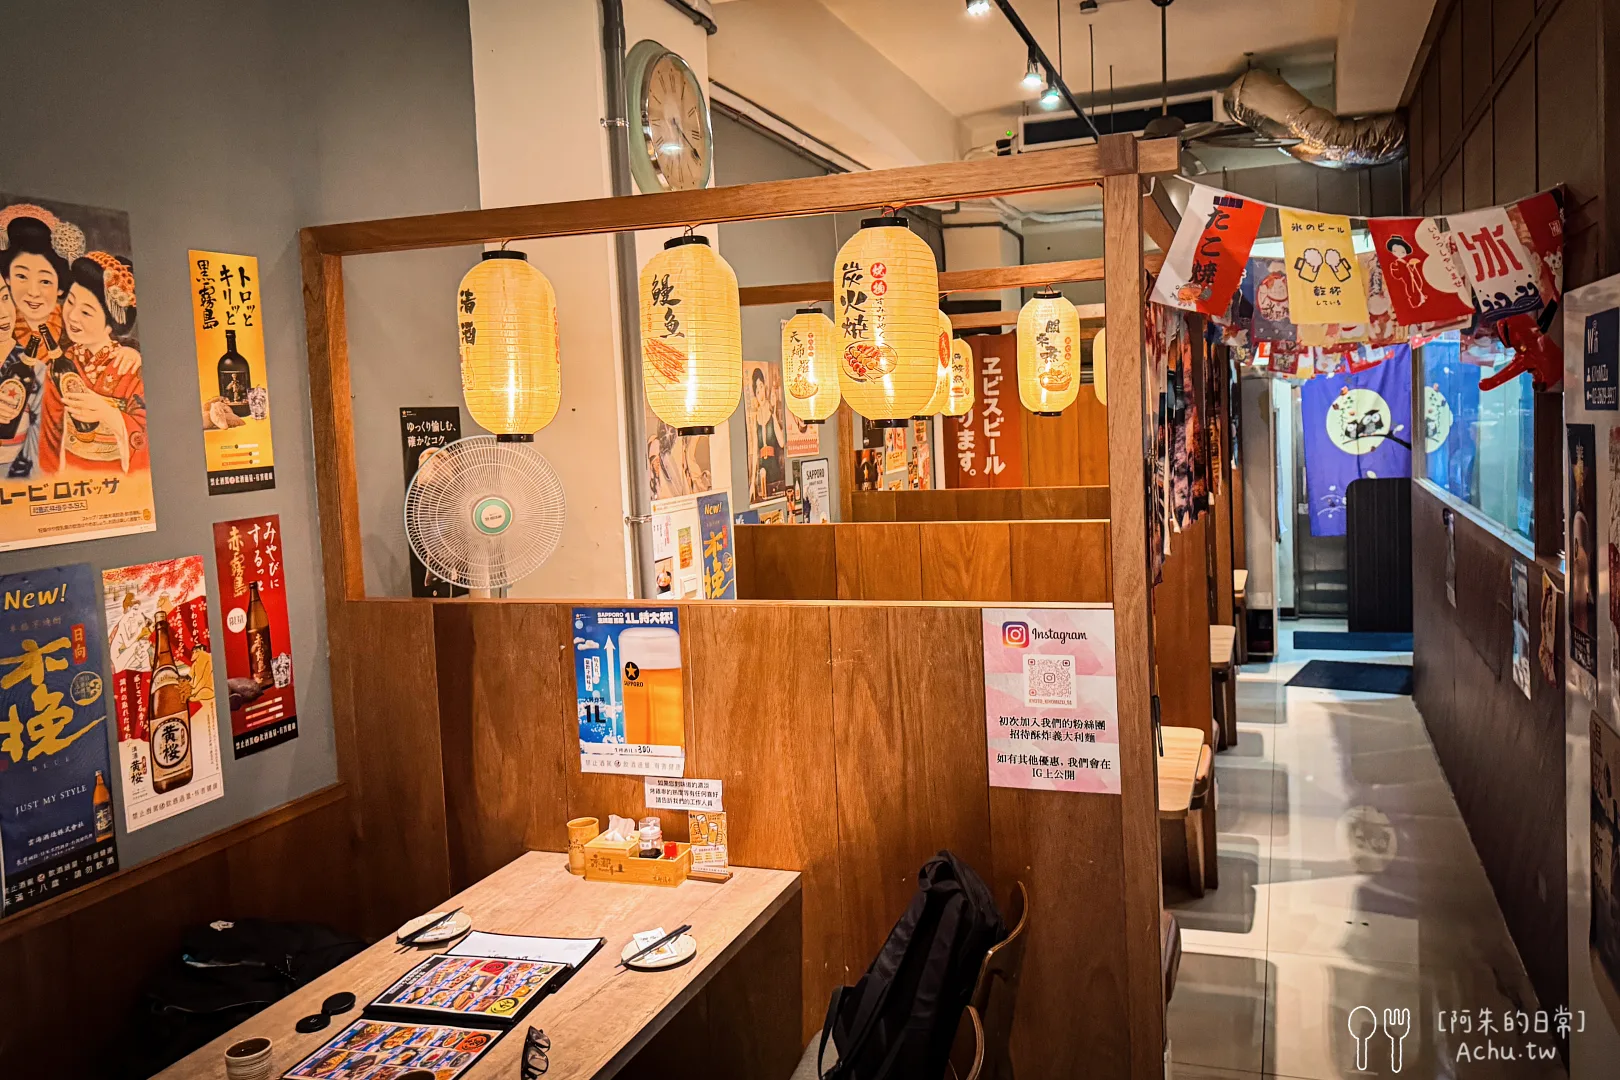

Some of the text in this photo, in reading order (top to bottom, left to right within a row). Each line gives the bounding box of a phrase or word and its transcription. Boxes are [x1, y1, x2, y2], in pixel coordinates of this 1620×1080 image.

[219, 264, 241, 326] キリッと
[238, 266, 256, 327] トロッと
[1313, 285, 1342, 296] 乾杯
[651, 273, 685, 338] 鰻魚
[806, 468, 825, 480] SAPPORO
[705, 502, 722, 515] New!
[227, 525, 248, 598] 赤霧島
[247, 523, 264, 592] するっと
[263, 521, 280, 589] みやびに
[3, 583, 67, 610] New!
[189, 604, 199, 644] やわらかく
[1031, 628, 1088, 645] Instagram
[73, 627, 87, 660] 日向
[624, 680, 644, 688] SAPPORO
[584, 705, 606, 724] 1L
[999, 715, 1107, 731] 初次加入我們的粉絲團
[1009, 729, 1096, 743] 招待酥炸義大利麵
[1032, 768, 1076, 781] IG上公開
[15, 784, 88, 815] JUST MY STYLE
